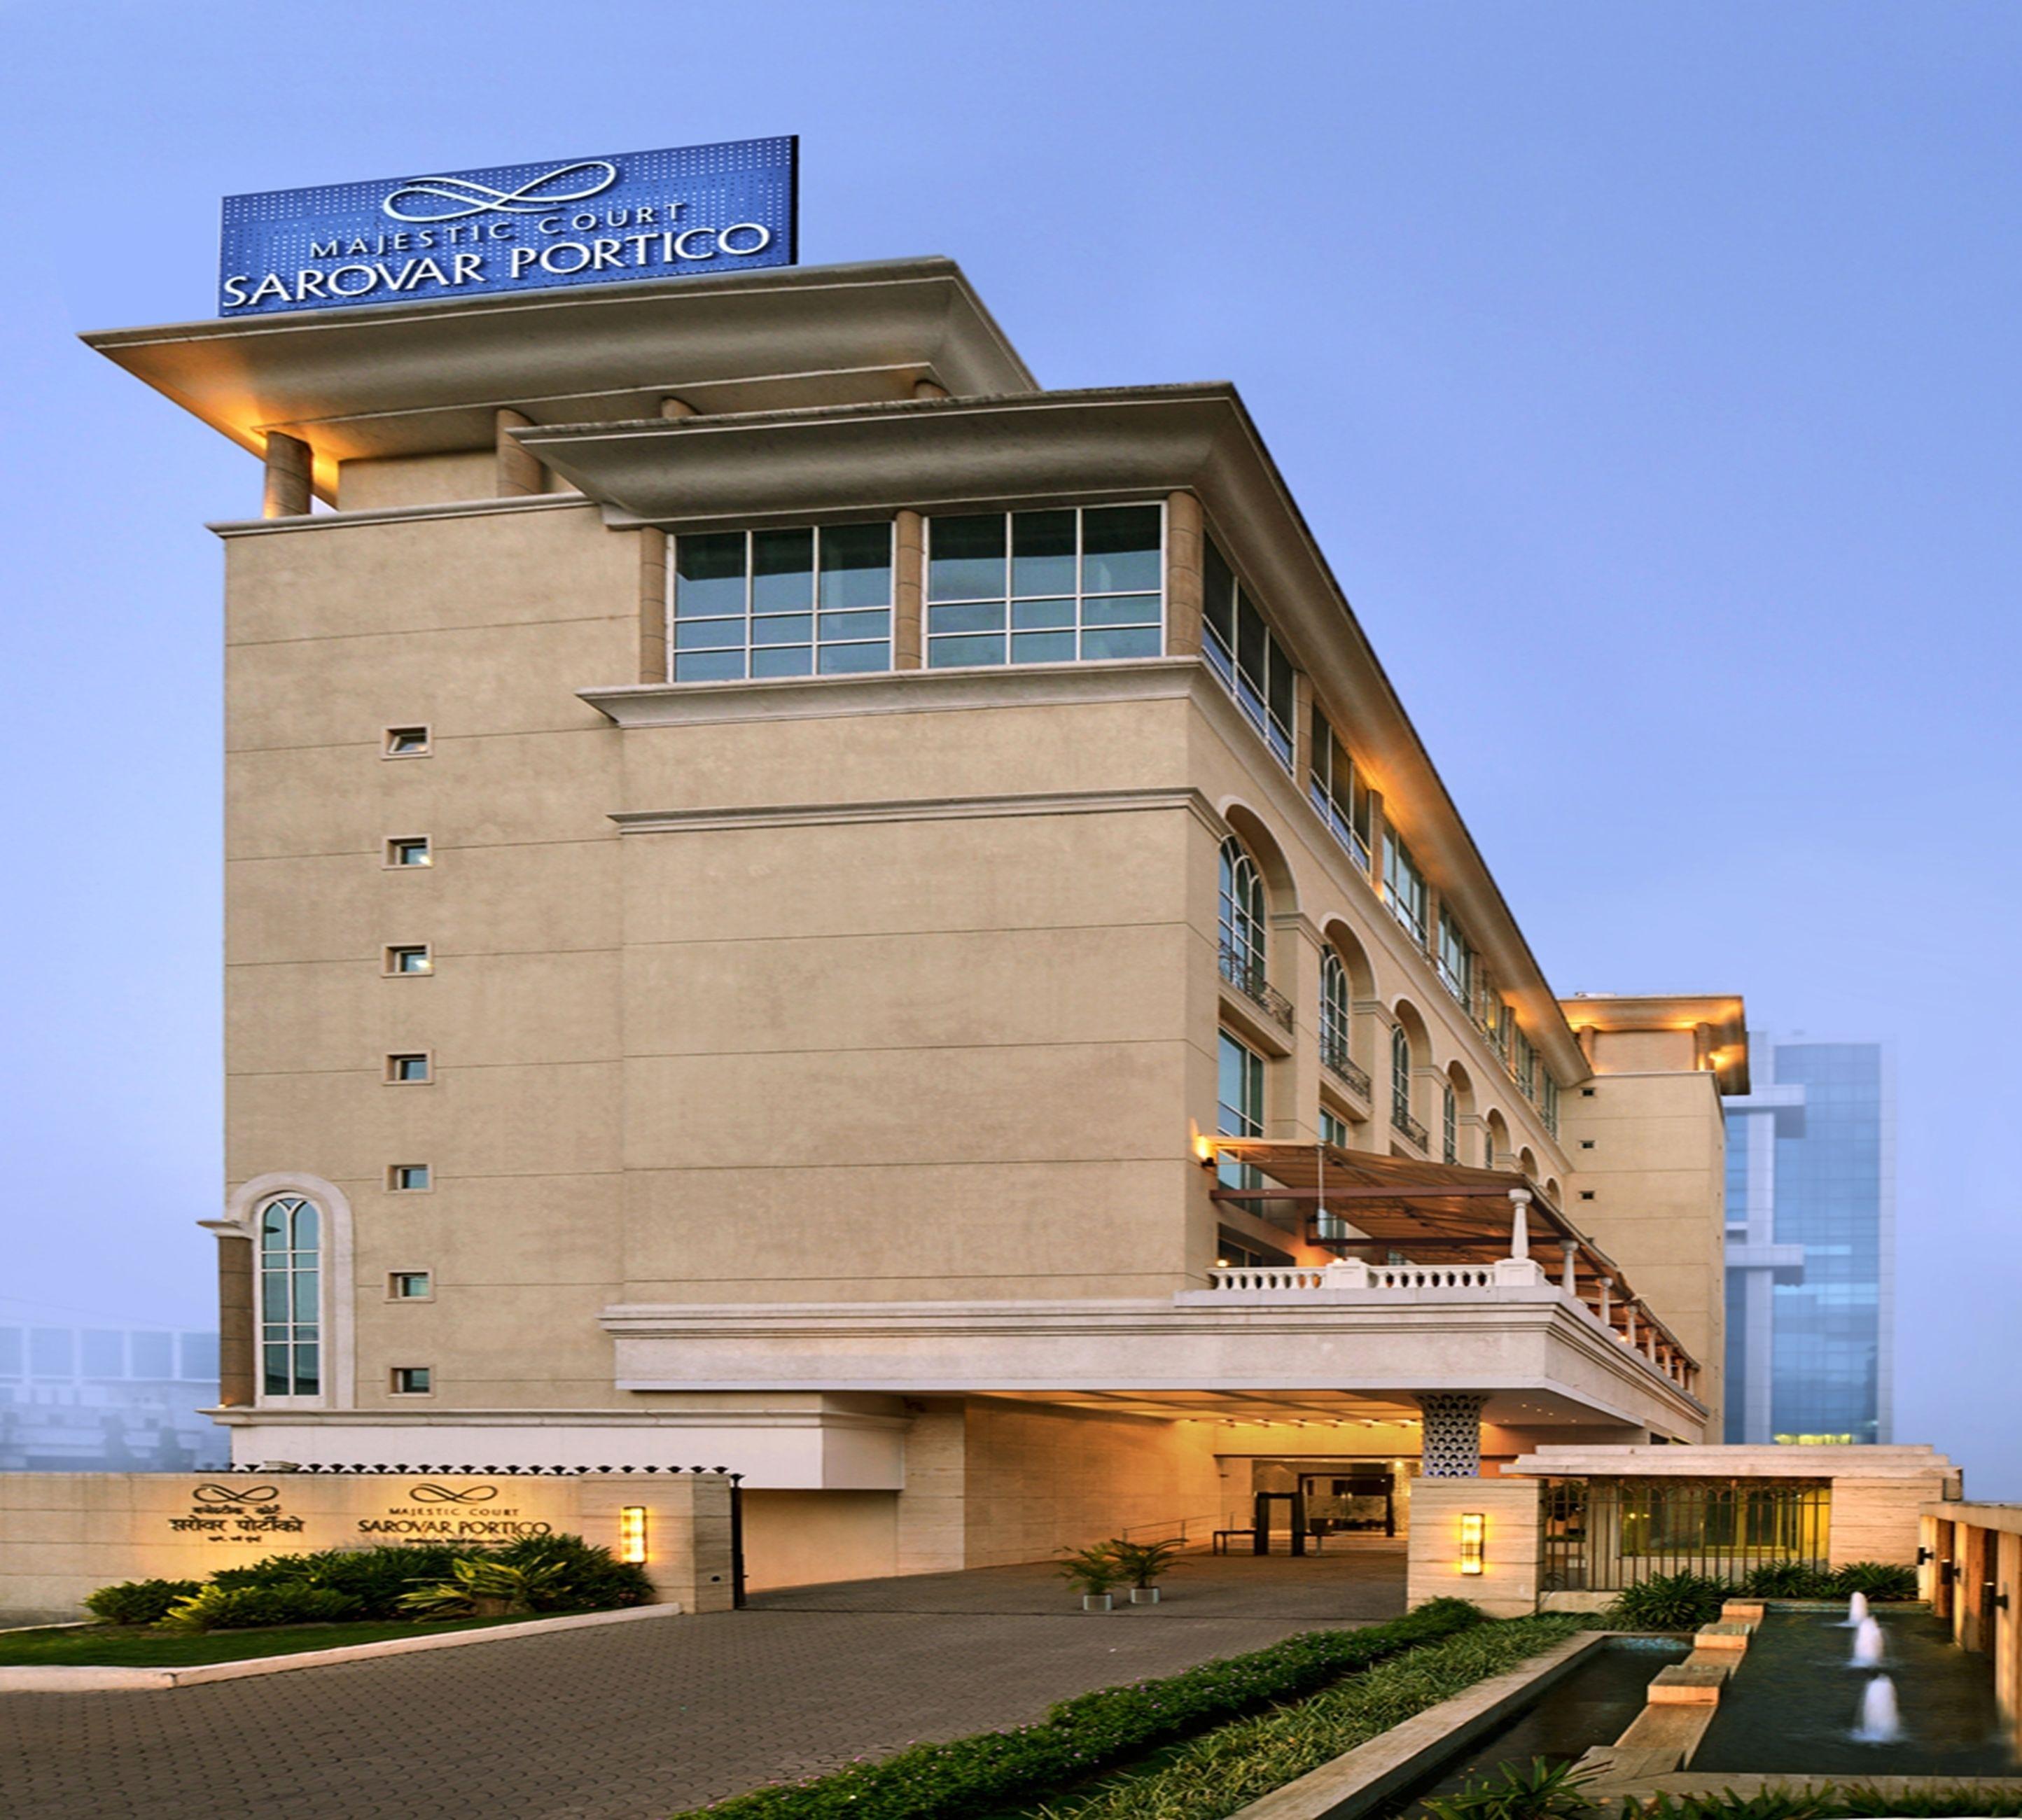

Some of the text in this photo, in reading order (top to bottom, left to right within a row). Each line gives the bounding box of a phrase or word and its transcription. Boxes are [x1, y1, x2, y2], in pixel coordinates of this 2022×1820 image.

[309, 202, 685, 258] MAJESTIC COURT
[222, 223, 770, 308] SAROVAR PORTICO
[169, 1515, 226, 1532] सरोवर
[358, 1520, 552, 1535] SAROVAR PORTICO
